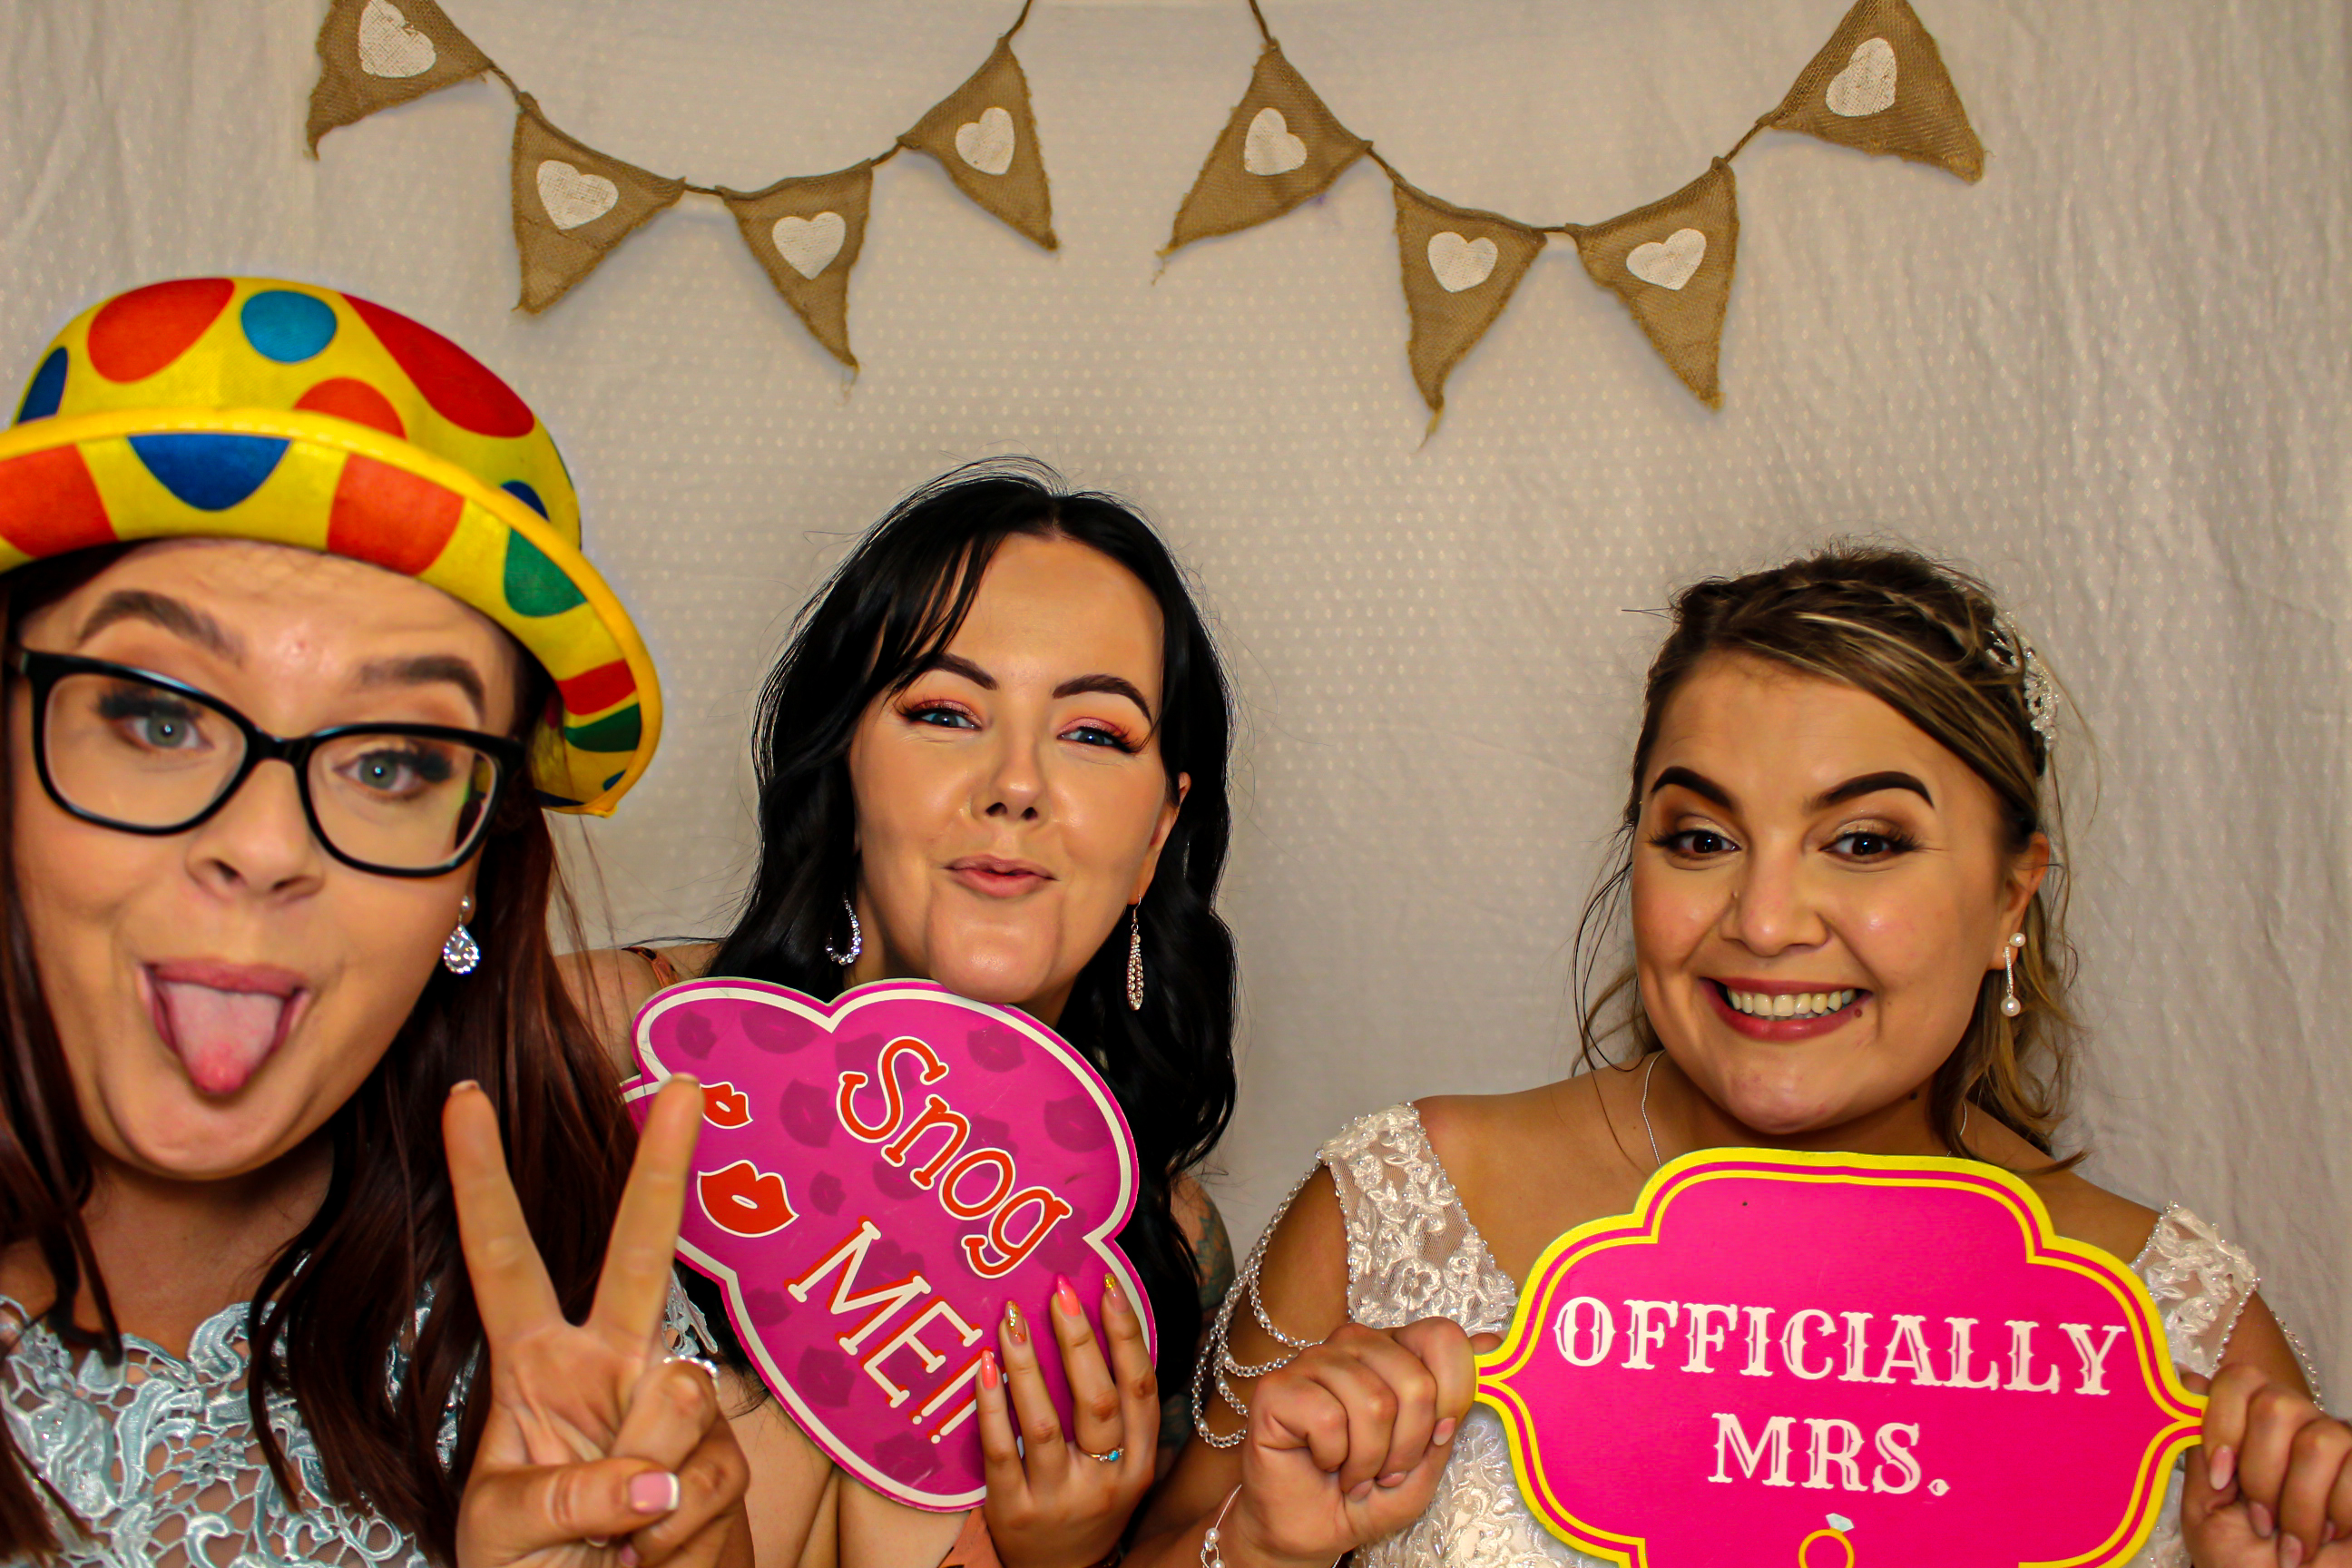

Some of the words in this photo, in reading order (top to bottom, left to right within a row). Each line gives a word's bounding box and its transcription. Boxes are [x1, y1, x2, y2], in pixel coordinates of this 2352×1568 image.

[836, 1036, 1073, 1279] Snog
[1553, 1296, 2127, 1396] OFFICIALLY
[1707, 1412, 1951, 1497] MRS.
